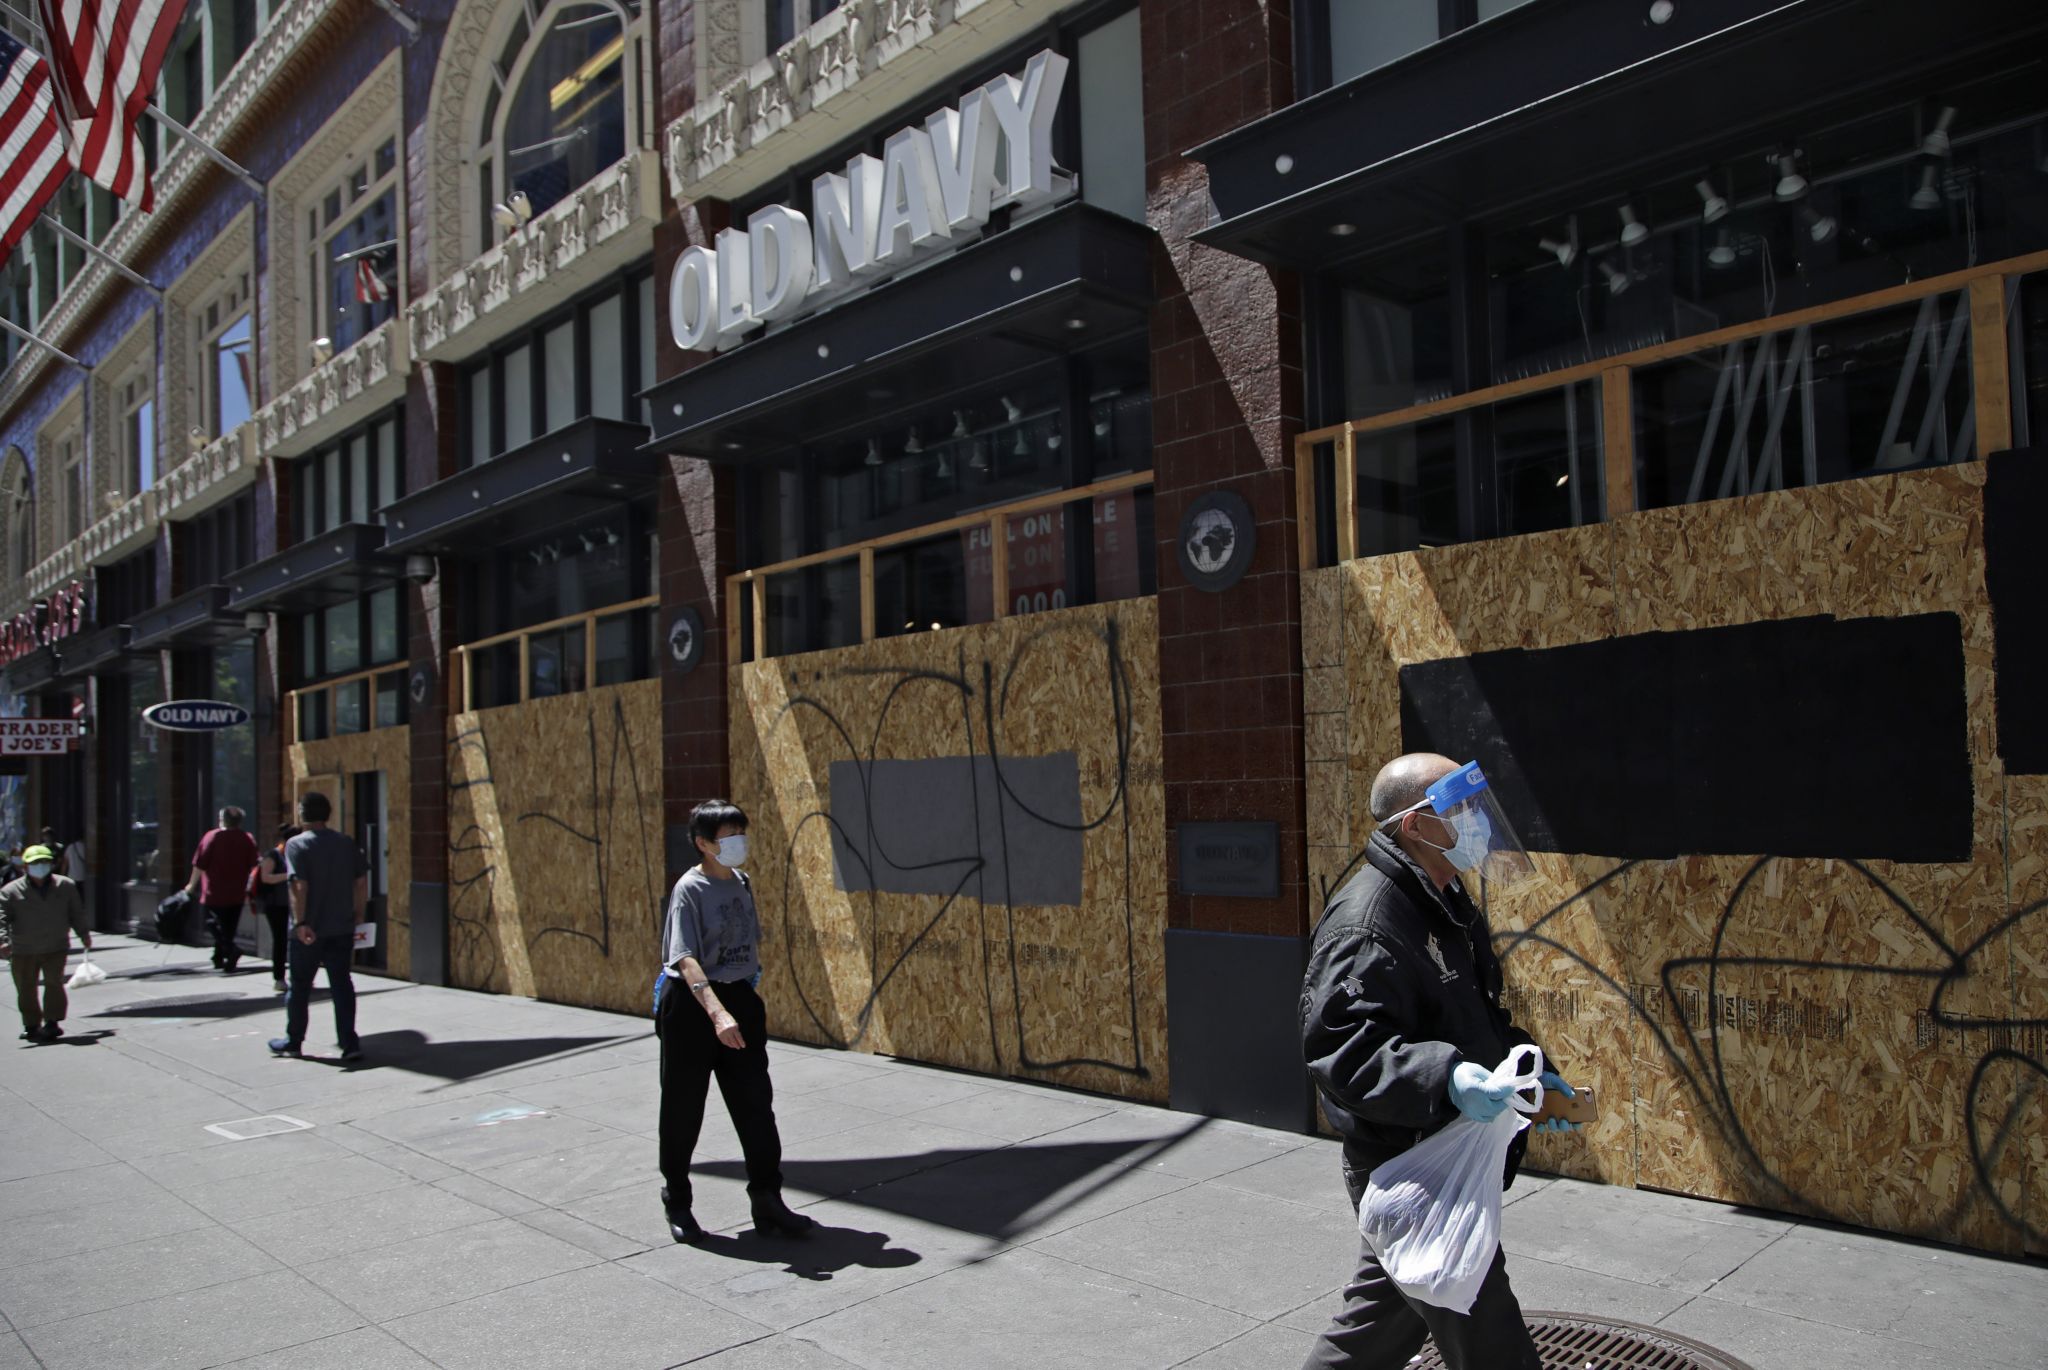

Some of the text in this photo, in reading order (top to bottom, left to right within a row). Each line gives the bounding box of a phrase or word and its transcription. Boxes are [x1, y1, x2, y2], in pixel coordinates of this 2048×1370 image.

[669, 47, 1070, 352] OLD NAVY
[970, 523, 1015, 550] FUL
[1023, 513, 1051, 538] ON
[158, 708, 240, 723] OLD NAVY
[0, 722, 74, 736] TRADER
[8, 737, 62, 751] JOE'S
